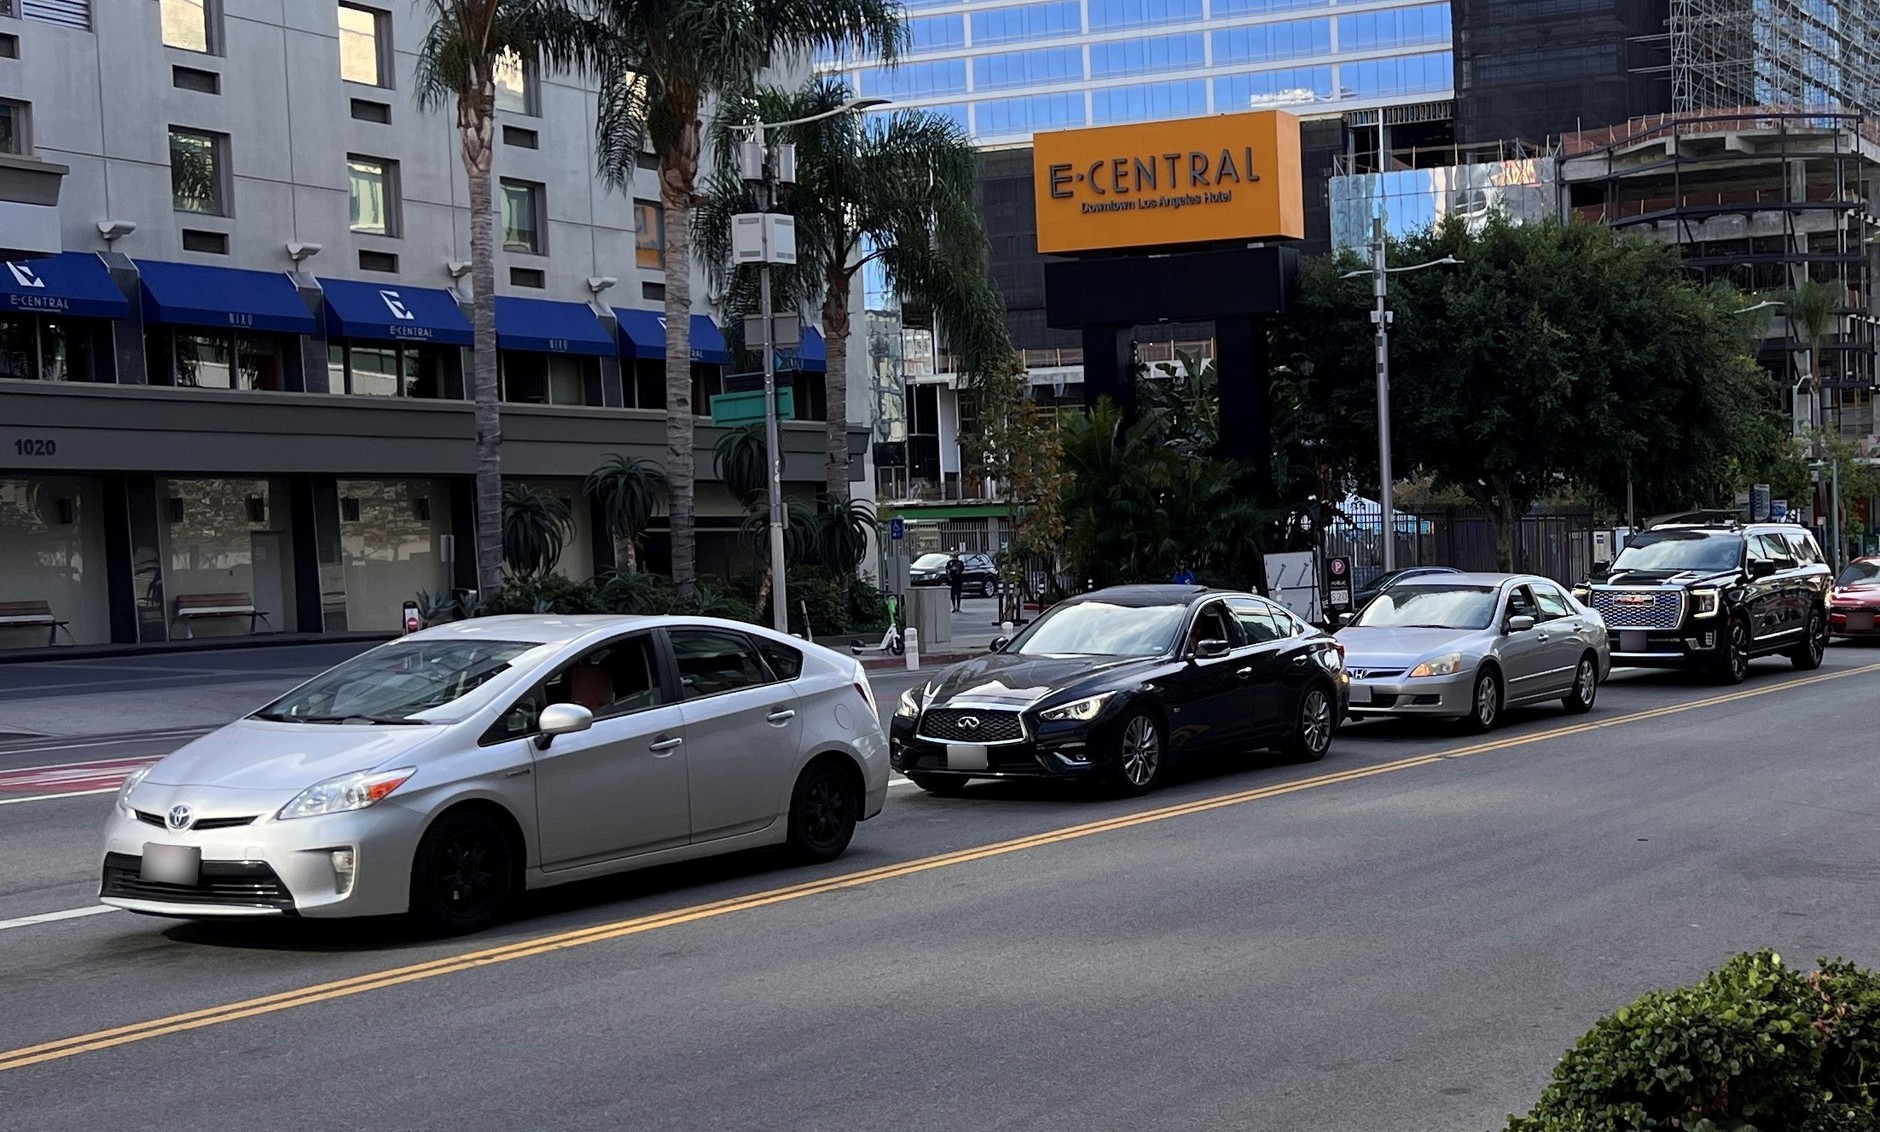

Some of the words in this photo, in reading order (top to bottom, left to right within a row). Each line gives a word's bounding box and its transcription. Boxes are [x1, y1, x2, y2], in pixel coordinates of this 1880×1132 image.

[1081, 200, 1135, 214] Downtown
[1138, 197, 1157, 210] Los
[1159, 194, 1201, 209] Angeles
[1204, 190, 1232, 204] Hotel
[14, 438, 56, 456] 1020
